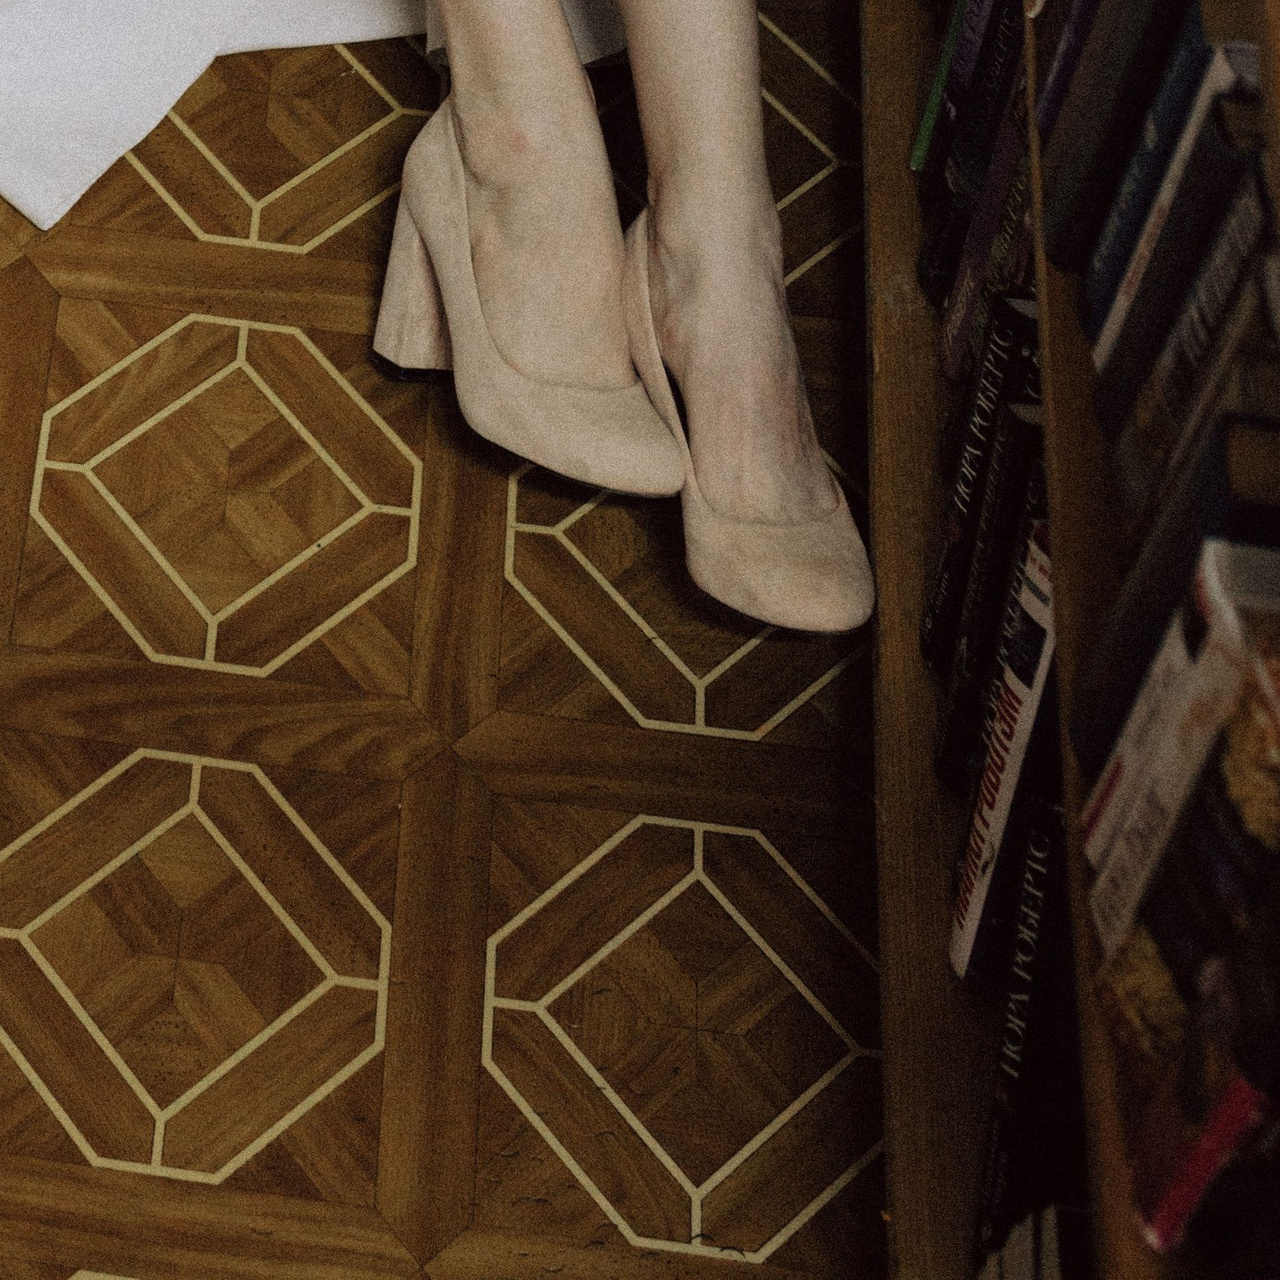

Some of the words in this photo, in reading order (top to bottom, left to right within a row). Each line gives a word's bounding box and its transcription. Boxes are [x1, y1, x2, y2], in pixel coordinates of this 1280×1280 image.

[954, 444, 984, 513] НОРА
[971, 324, 1015, 443] РОБЕРТС
[1013, 834, 1052, 985] РОБЕРТС
[1002, 990, 1031, 1078] НОРА
